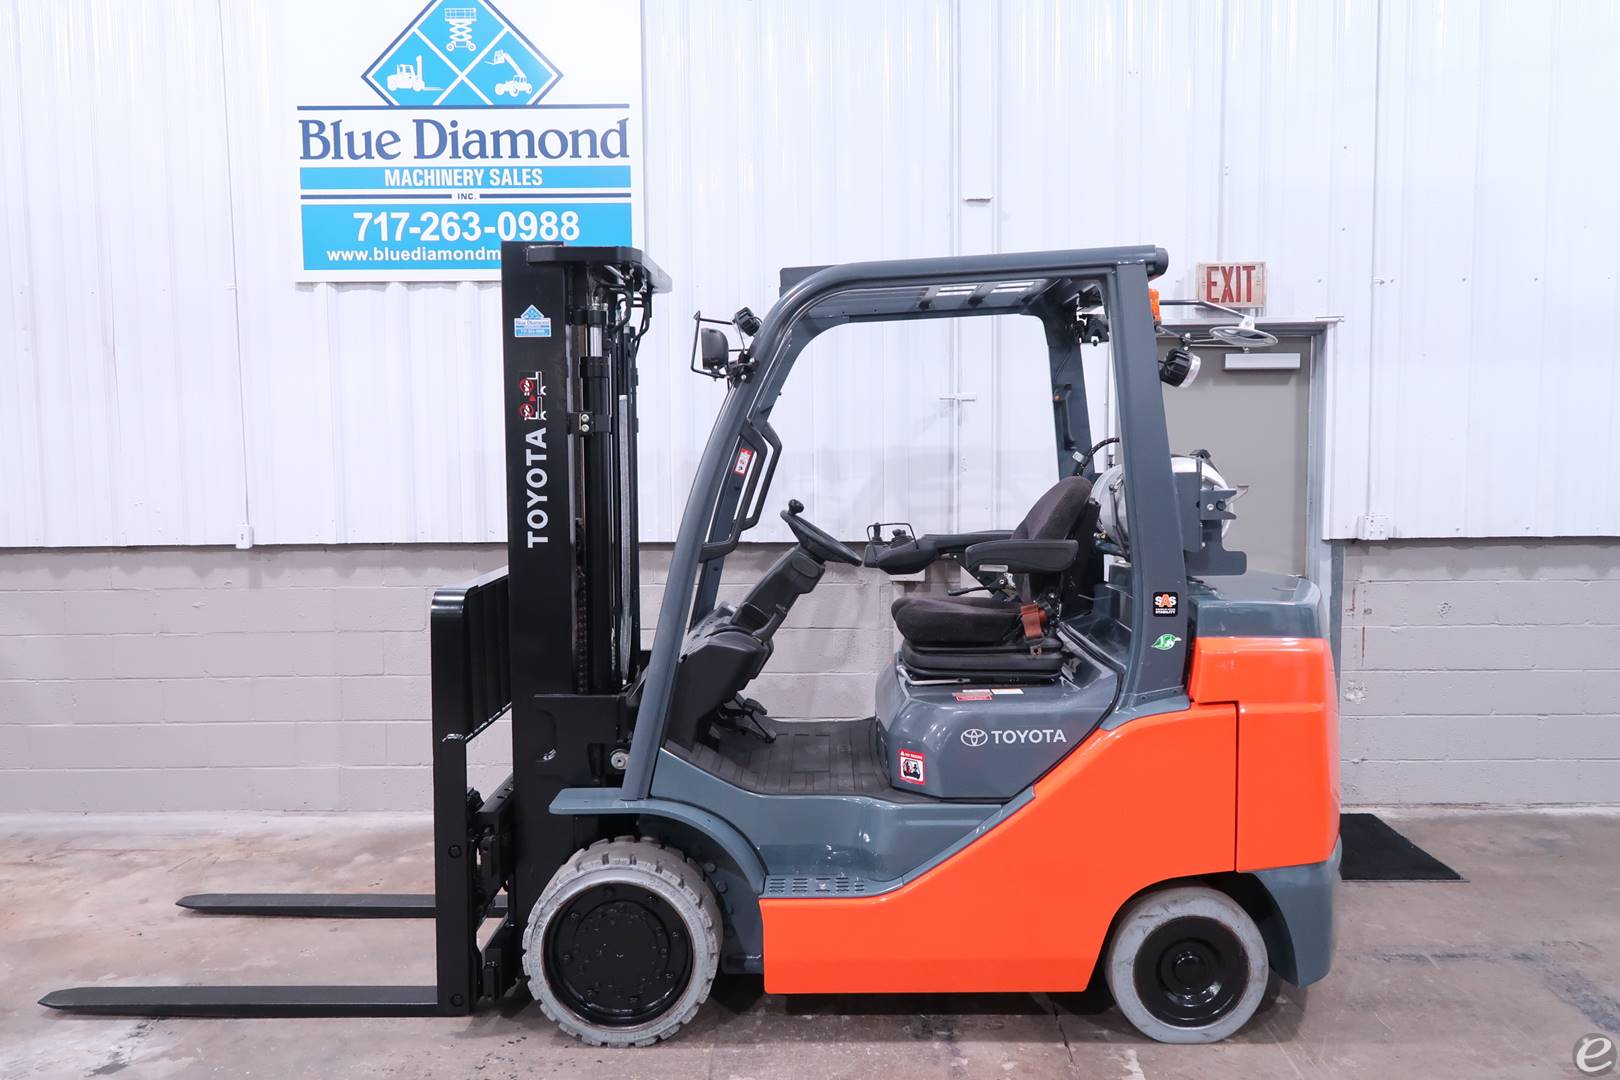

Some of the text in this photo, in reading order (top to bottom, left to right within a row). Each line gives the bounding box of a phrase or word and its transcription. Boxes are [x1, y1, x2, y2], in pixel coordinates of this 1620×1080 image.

[298, 117, 630, 161] Blue Diamond
[384, 167, 544, 188] MACHINERY SALES
[457, 192, 478, 201] INC.
[352, 210, 581, 242] 717-263-0988
[327, 246, 502, 262] www.bluediamondm
[1206, 265, 1256, 303] EXIT
[525, 427, 549, 549] TOYOTA
[1154, 594, 1177, 608] SAS
[991, 729, 1067, 744] TOYOTA
